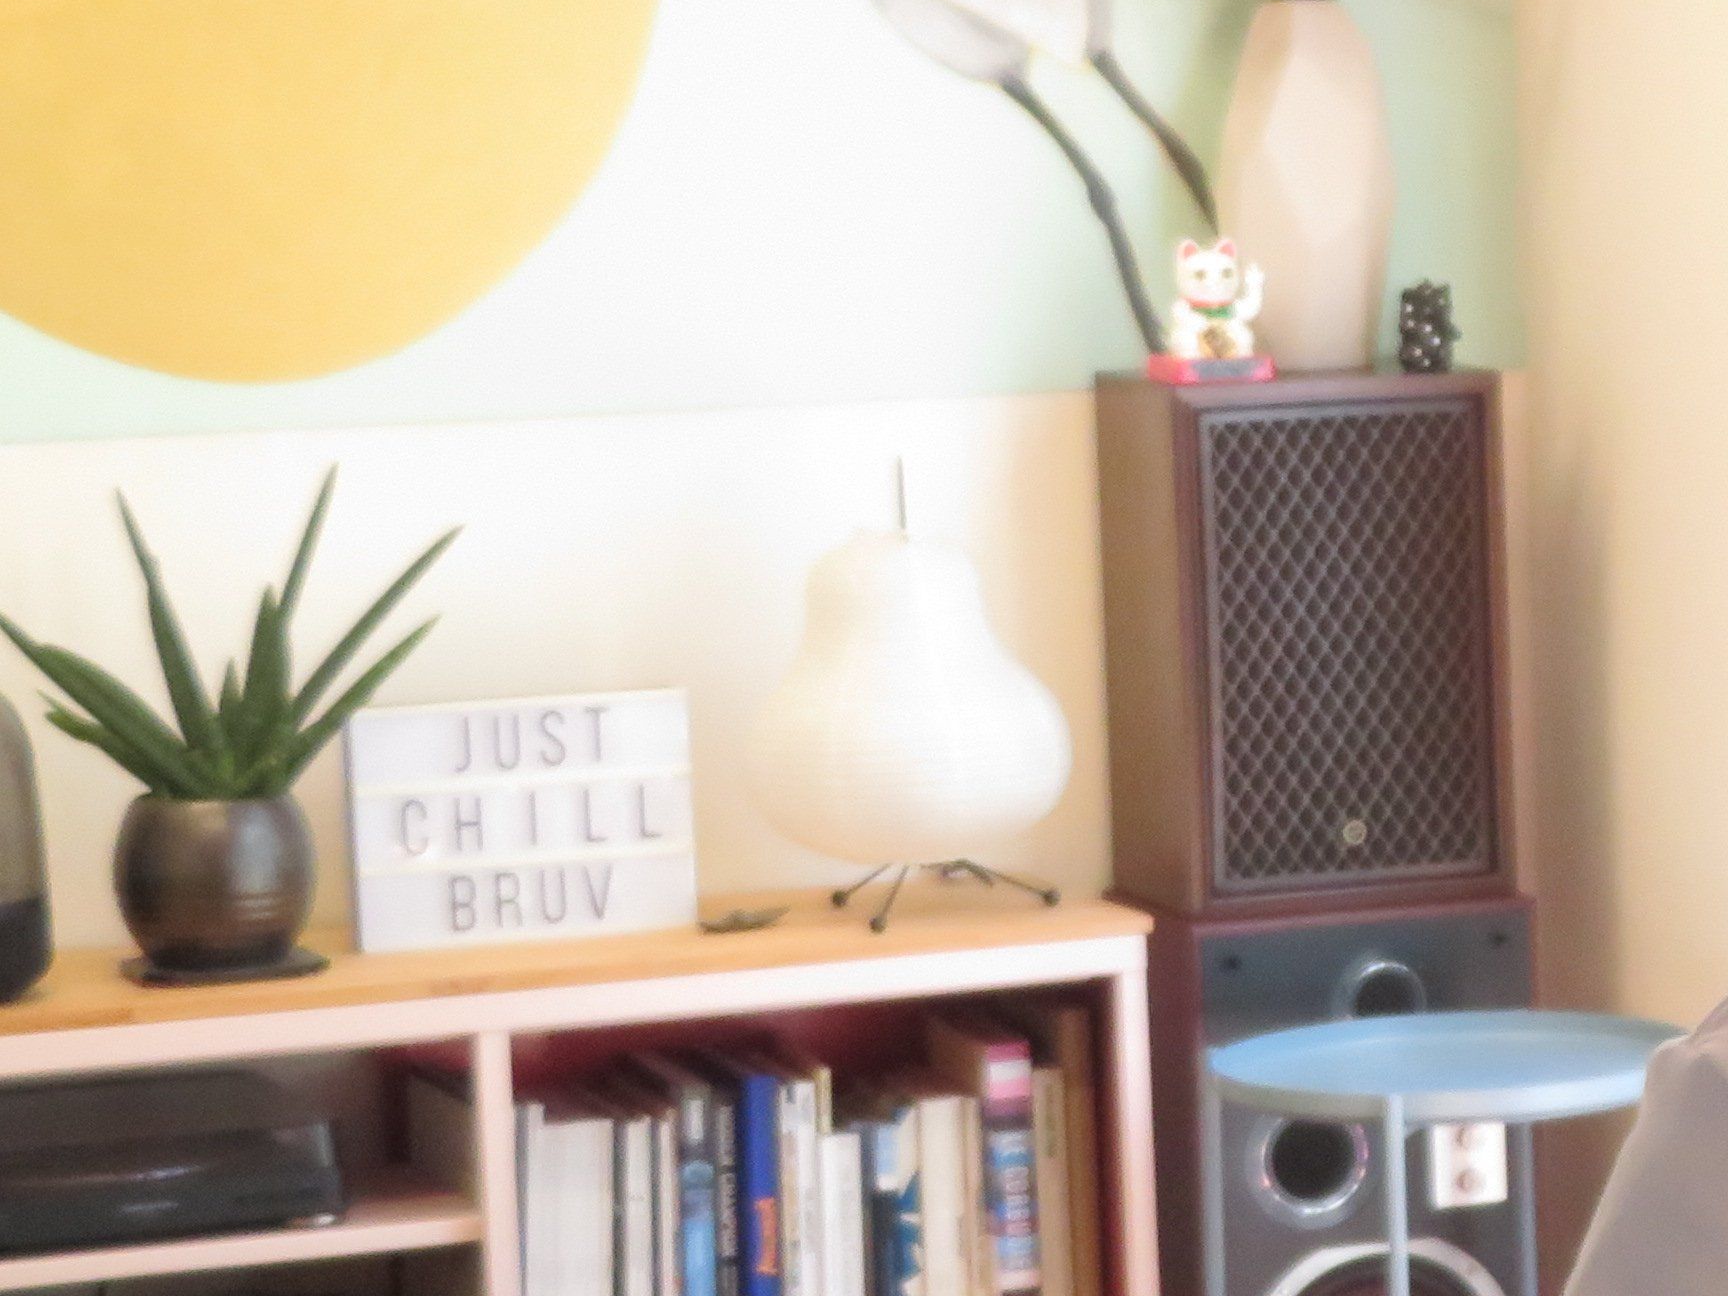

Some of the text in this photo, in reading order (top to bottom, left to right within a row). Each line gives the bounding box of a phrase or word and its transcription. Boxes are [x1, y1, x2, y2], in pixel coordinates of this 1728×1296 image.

[455, 704, 609, 773] JUST
[398, 782, 663, 856] CHILL
[449, 863, 614, 932] BRUV
